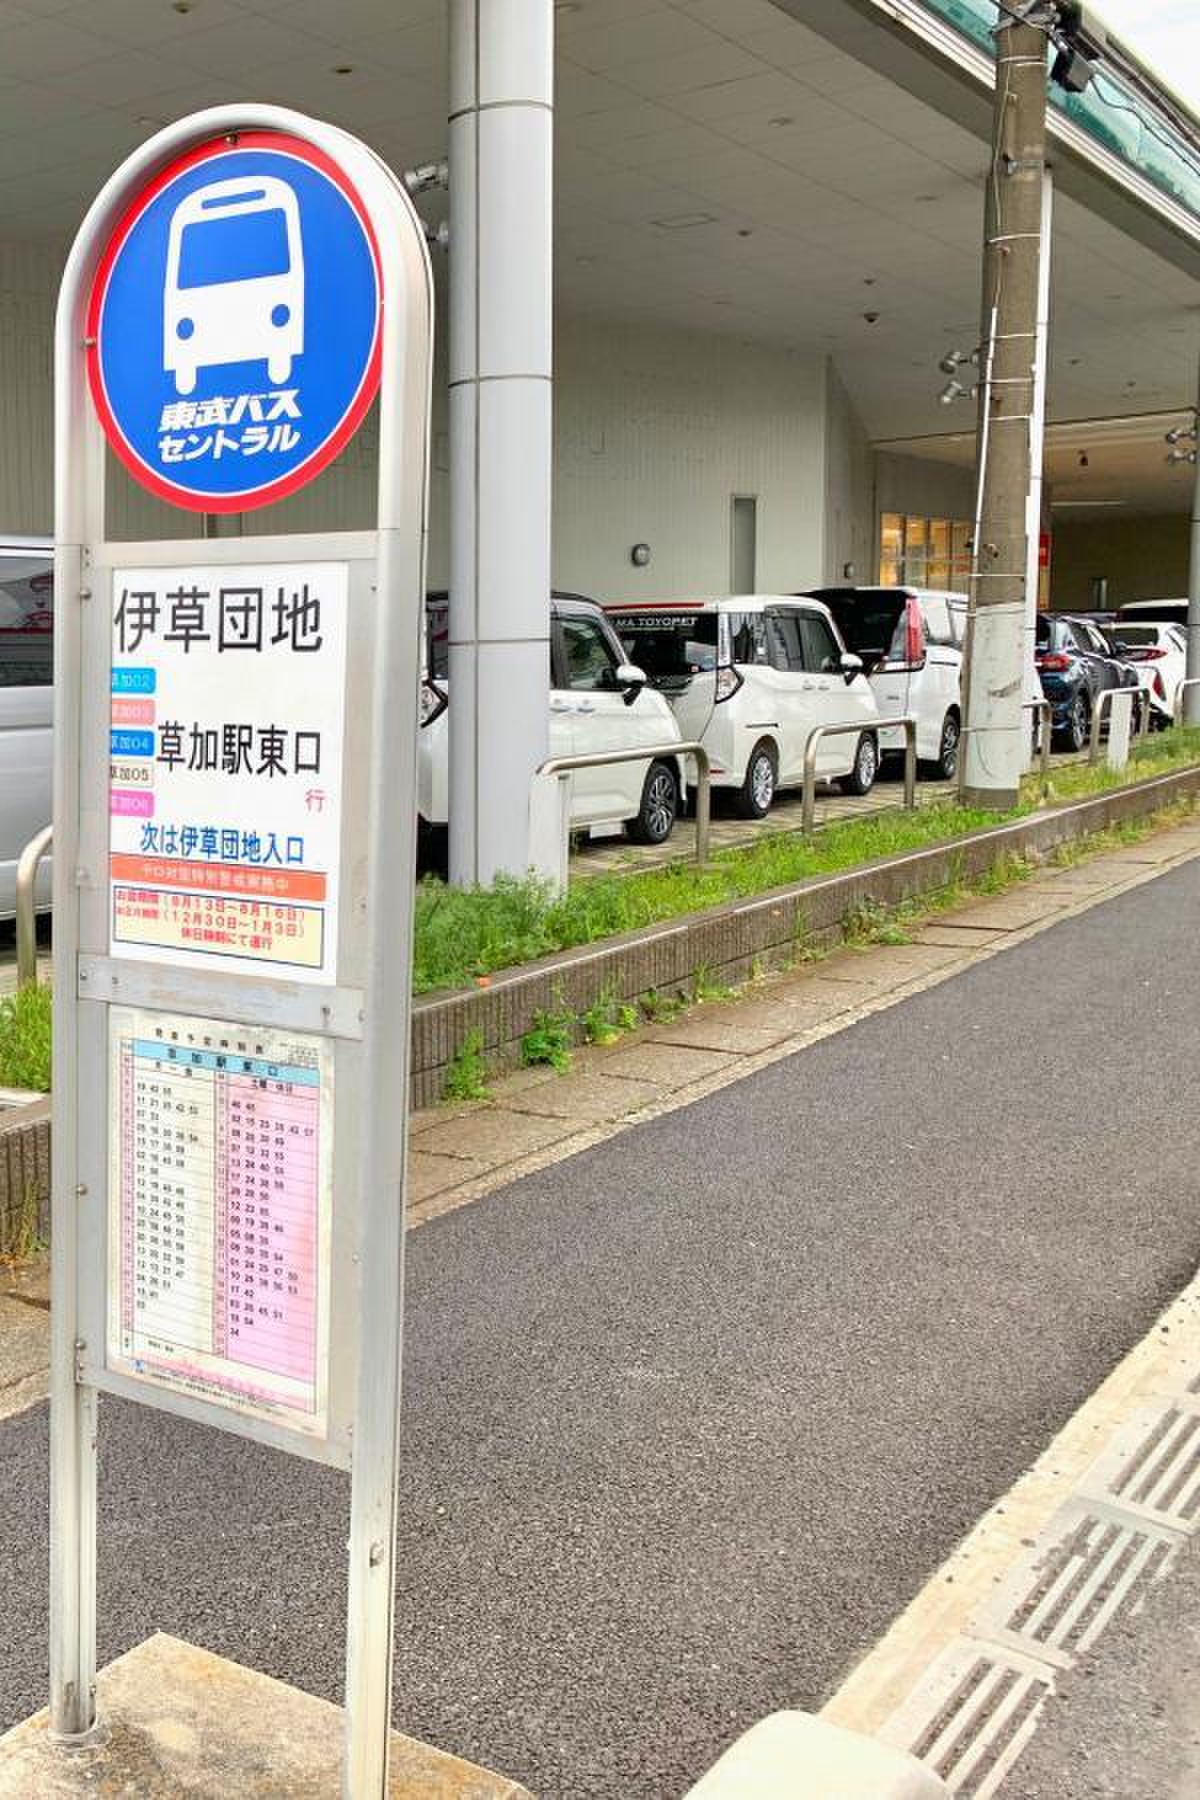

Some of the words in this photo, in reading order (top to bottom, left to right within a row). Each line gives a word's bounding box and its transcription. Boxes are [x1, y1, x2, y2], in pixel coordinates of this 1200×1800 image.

[157, 388, 304, 433] 東武バス
[158, 424, 302, 464] セントラル
[114, 585, 322, 653] 伊草団地
[156, 719, 321, 778] 草加駅東口
[305, 789, 327, 812] 行
[140, 823, 305, 864] 次は伊草団地入口
